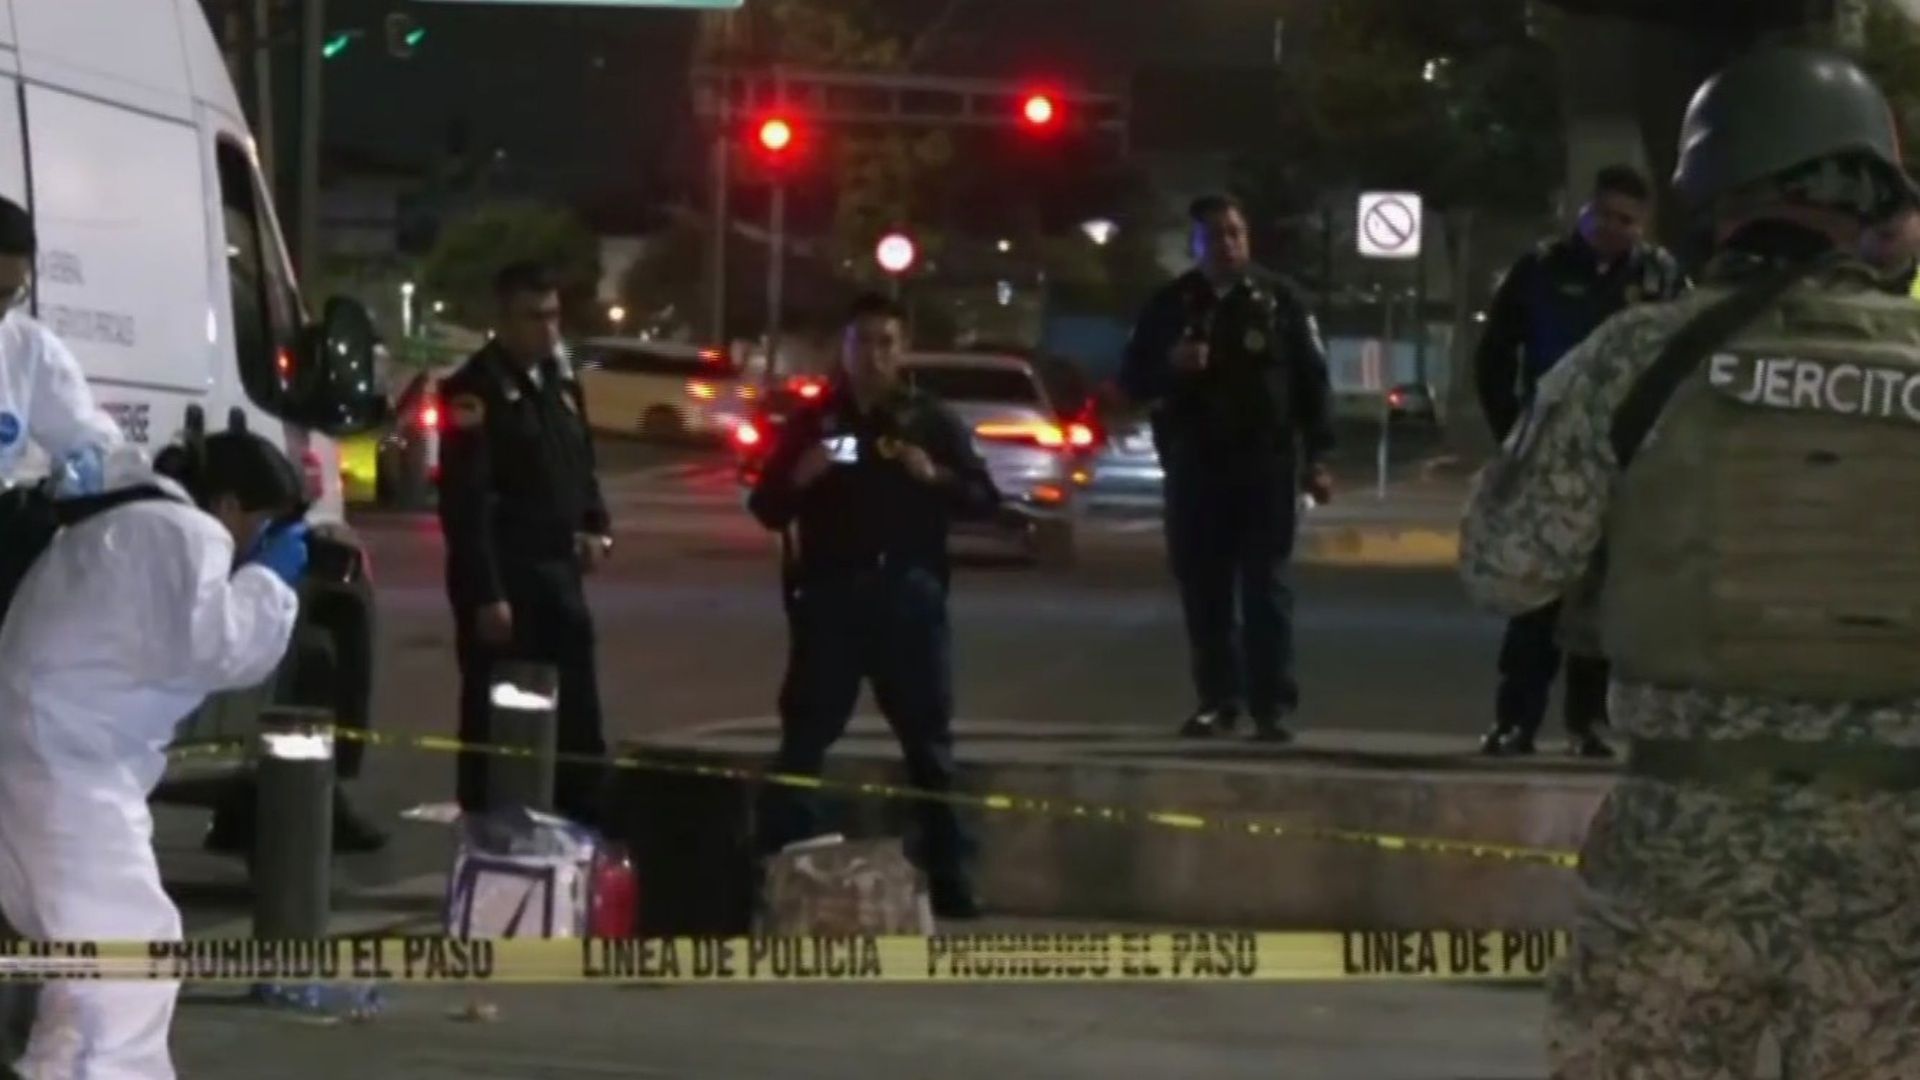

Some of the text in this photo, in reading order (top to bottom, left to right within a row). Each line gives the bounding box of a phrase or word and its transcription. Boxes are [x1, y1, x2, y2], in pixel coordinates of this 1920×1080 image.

[148, 937, 496, 978] PROHIBIDO EL PASO
[581, 936, 882, 977] LINEA DE POLICIA
[926, 932, 1258, 976] PROHIBIDO EL PASO
[1343, 930, 1437, 973] LINEA
[1449, 930, 1491, 973] DE
